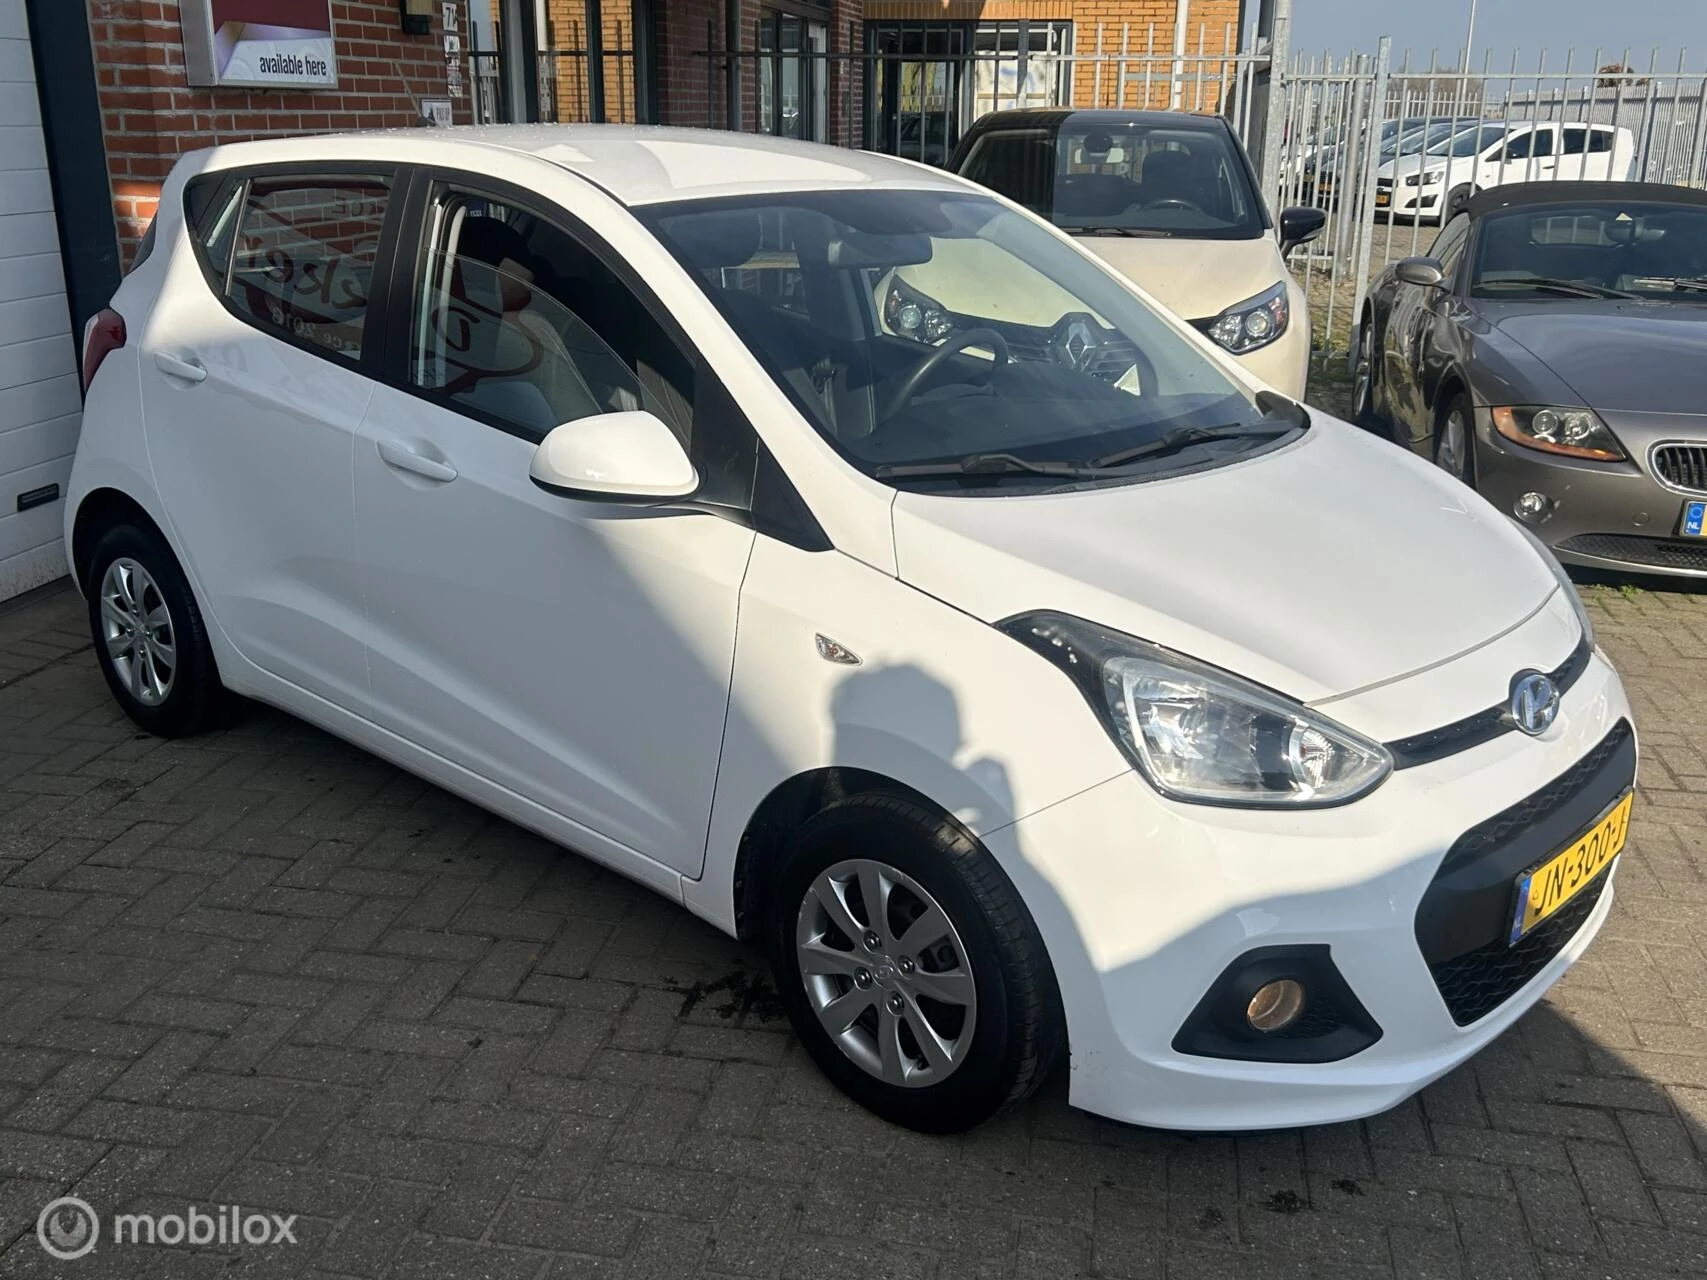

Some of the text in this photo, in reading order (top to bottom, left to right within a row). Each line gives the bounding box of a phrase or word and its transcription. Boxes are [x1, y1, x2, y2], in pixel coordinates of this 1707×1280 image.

[259, 53, 327, 76] available here
[1687, 521, 1700, 530] NL
[1534, 805, 1626, 917] JN-300-J
